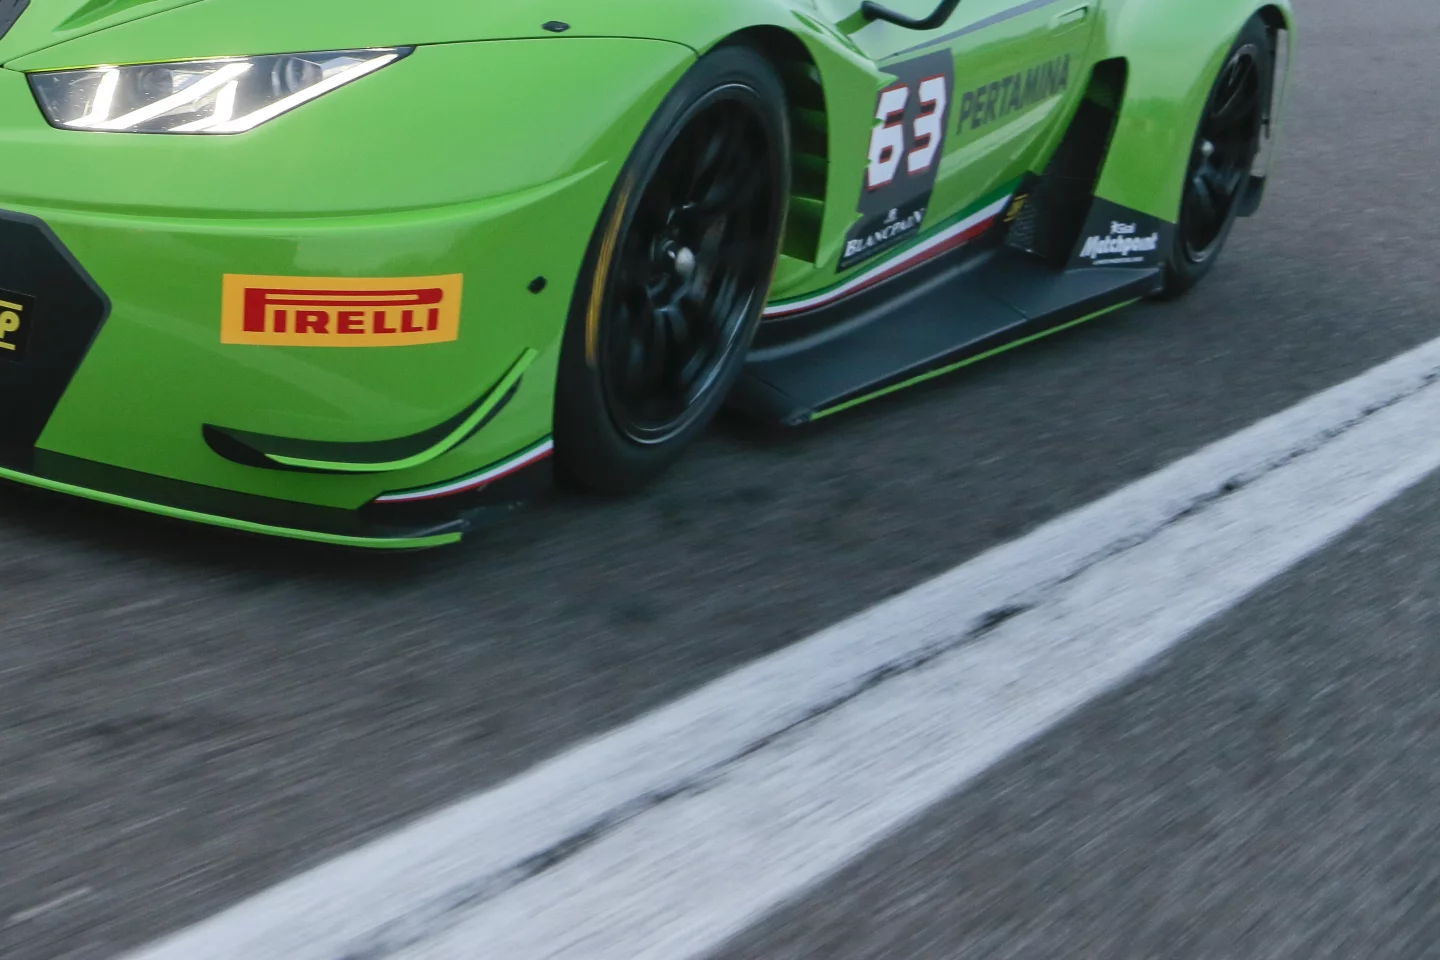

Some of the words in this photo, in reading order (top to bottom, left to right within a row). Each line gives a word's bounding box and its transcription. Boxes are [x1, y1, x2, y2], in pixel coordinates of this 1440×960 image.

[866, 73, 947, 191] 63
[957, 54, 1071, 136] PERTAMINA
[242, 288, 443, 335] PIRELLI
